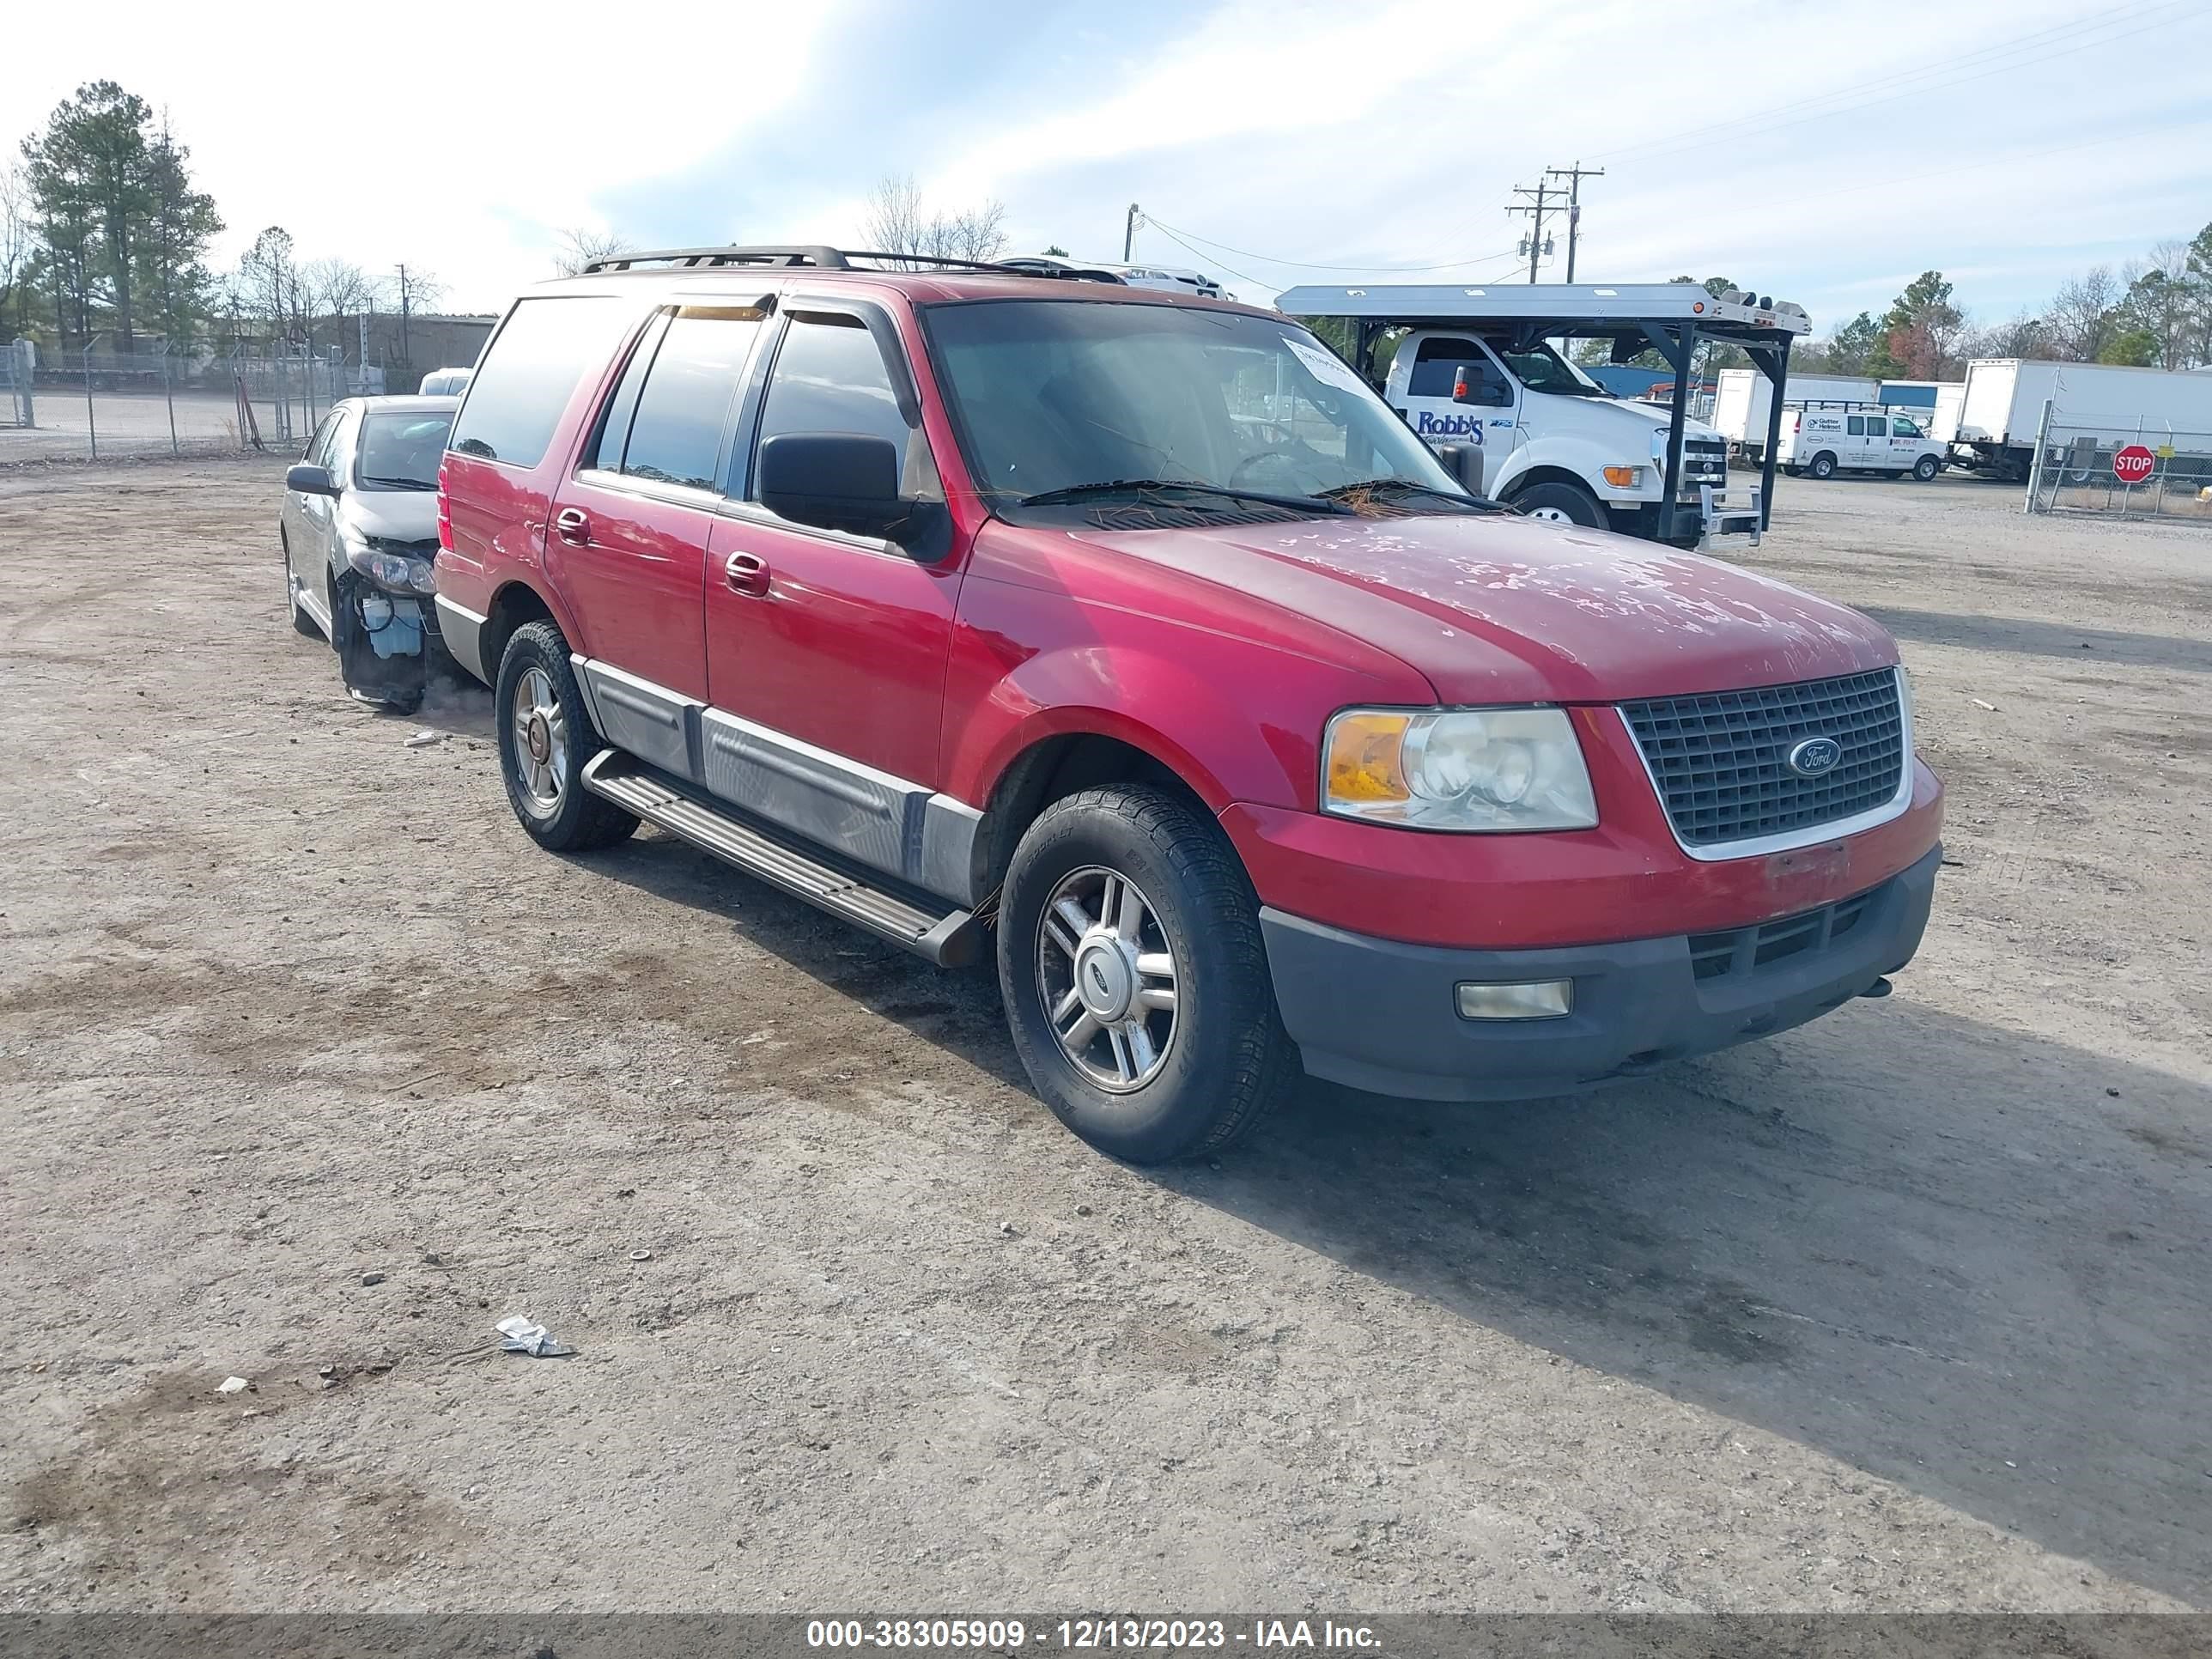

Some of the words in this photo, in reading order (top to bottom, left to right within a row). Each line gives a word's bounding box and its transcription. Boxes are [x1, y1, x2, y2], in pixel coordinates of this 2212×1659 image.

[1419, 411, 1483, 446] Robb's
[2116, 456, 2152, 471] STOP
[1805, 745, 1832, 768] Ford
